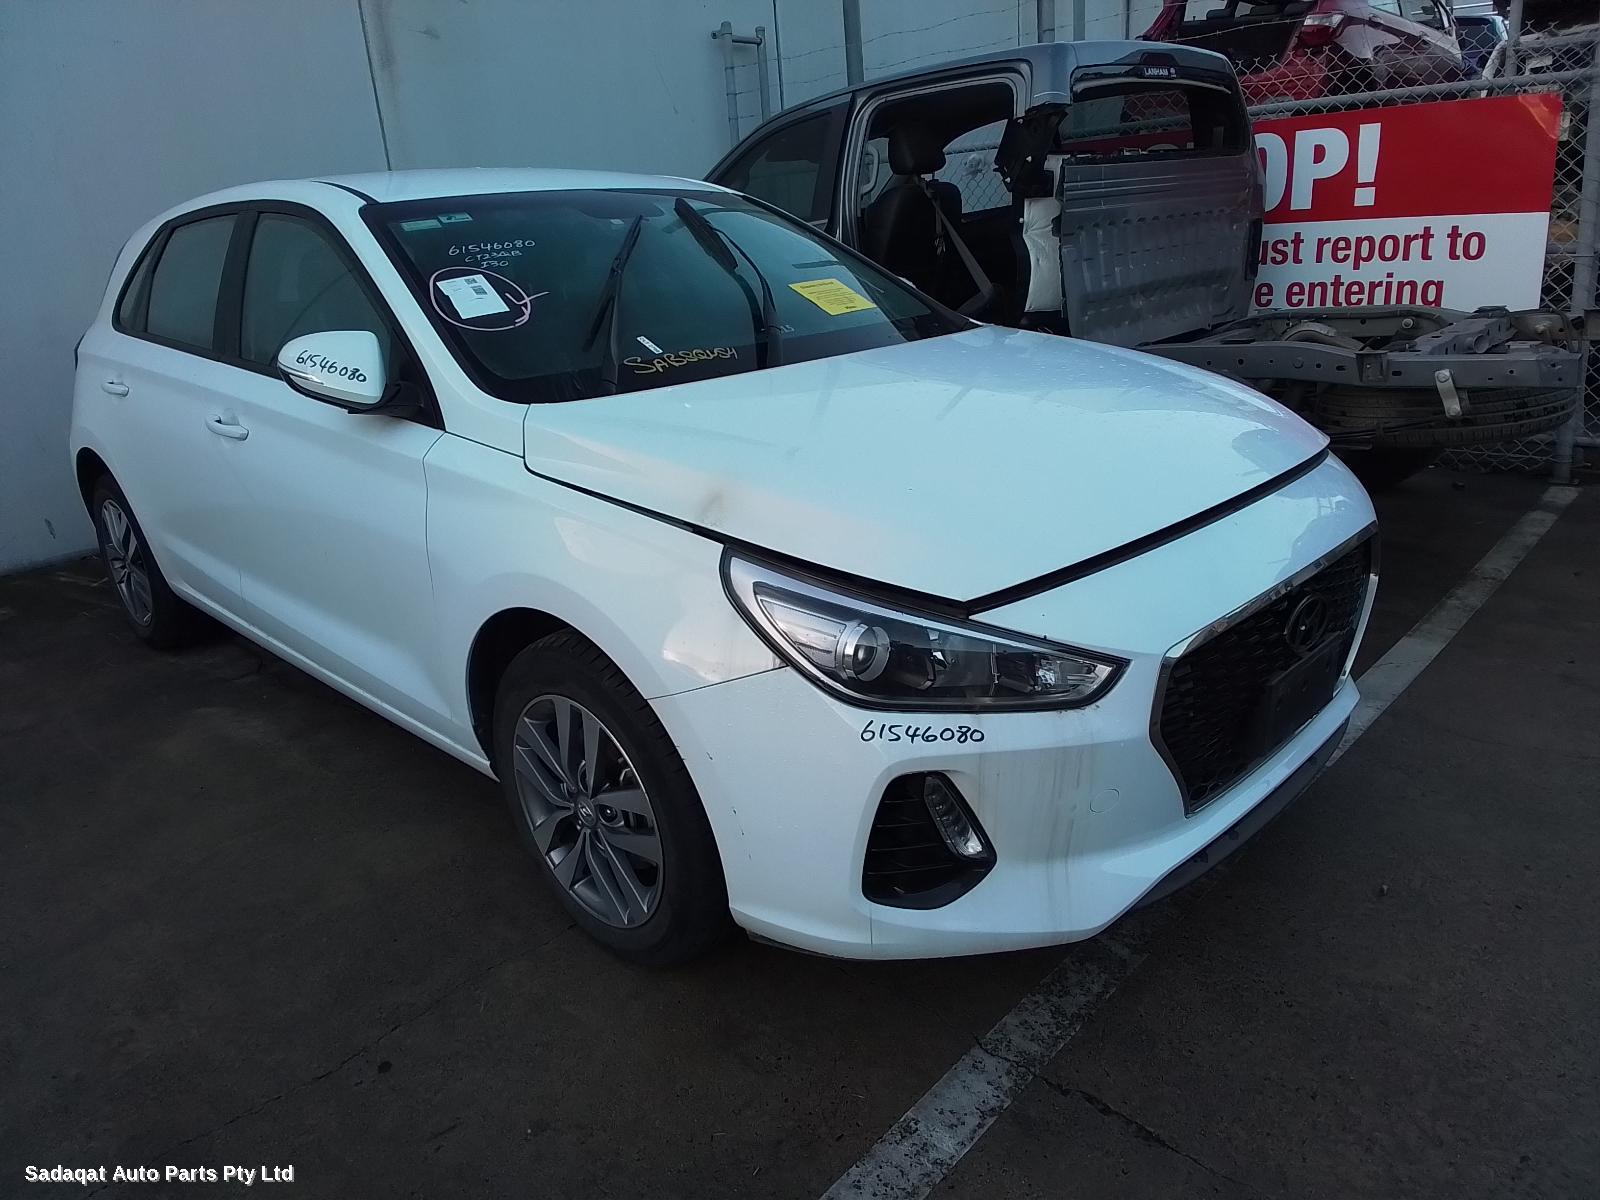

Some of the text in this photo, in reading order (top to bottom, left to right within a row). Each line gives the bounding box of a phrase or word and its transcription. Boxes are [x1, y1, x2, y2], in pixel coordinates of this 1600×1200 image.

[448, 240, 536, 256] 61546080
[1315, 225, 1434, 270] report
[1447, 225, 1486, 261] to
[1285, 272, 1445, 308] entering
[295, 349, 368, 383] 61546080
[860, 719, 985, 744] 61546080
